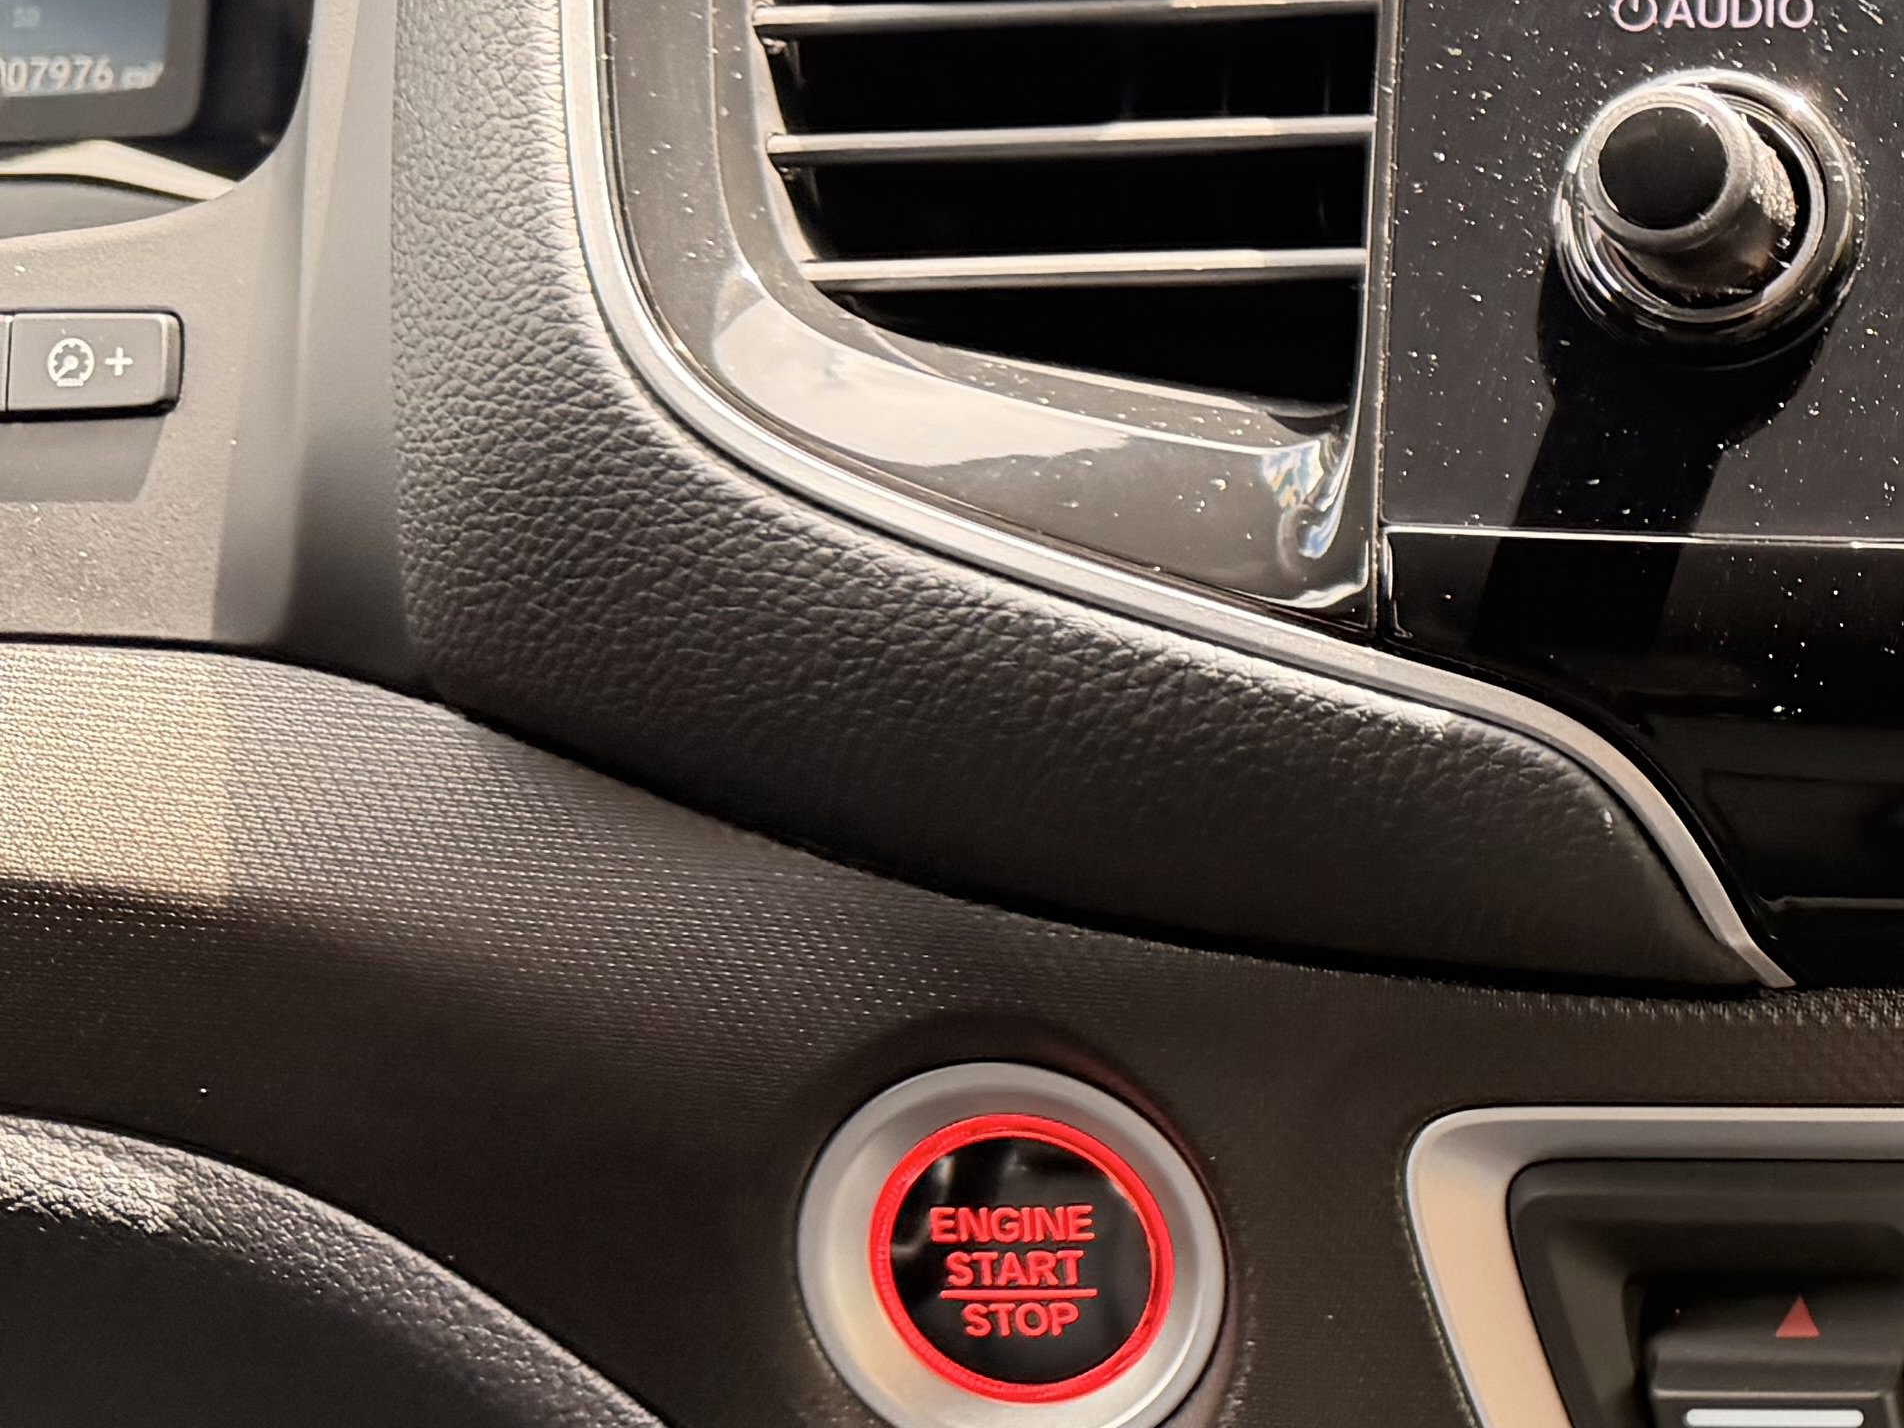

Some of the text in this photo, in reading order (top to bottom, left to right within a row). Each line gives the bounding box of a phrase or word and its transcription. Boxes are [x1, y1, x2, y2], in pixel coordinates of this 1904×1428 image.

[930, 1205, 1095, 1243] ENGINE
[945, 1250, 1084, 1287] START
[962, 1302, 1079, 1337] STOP
